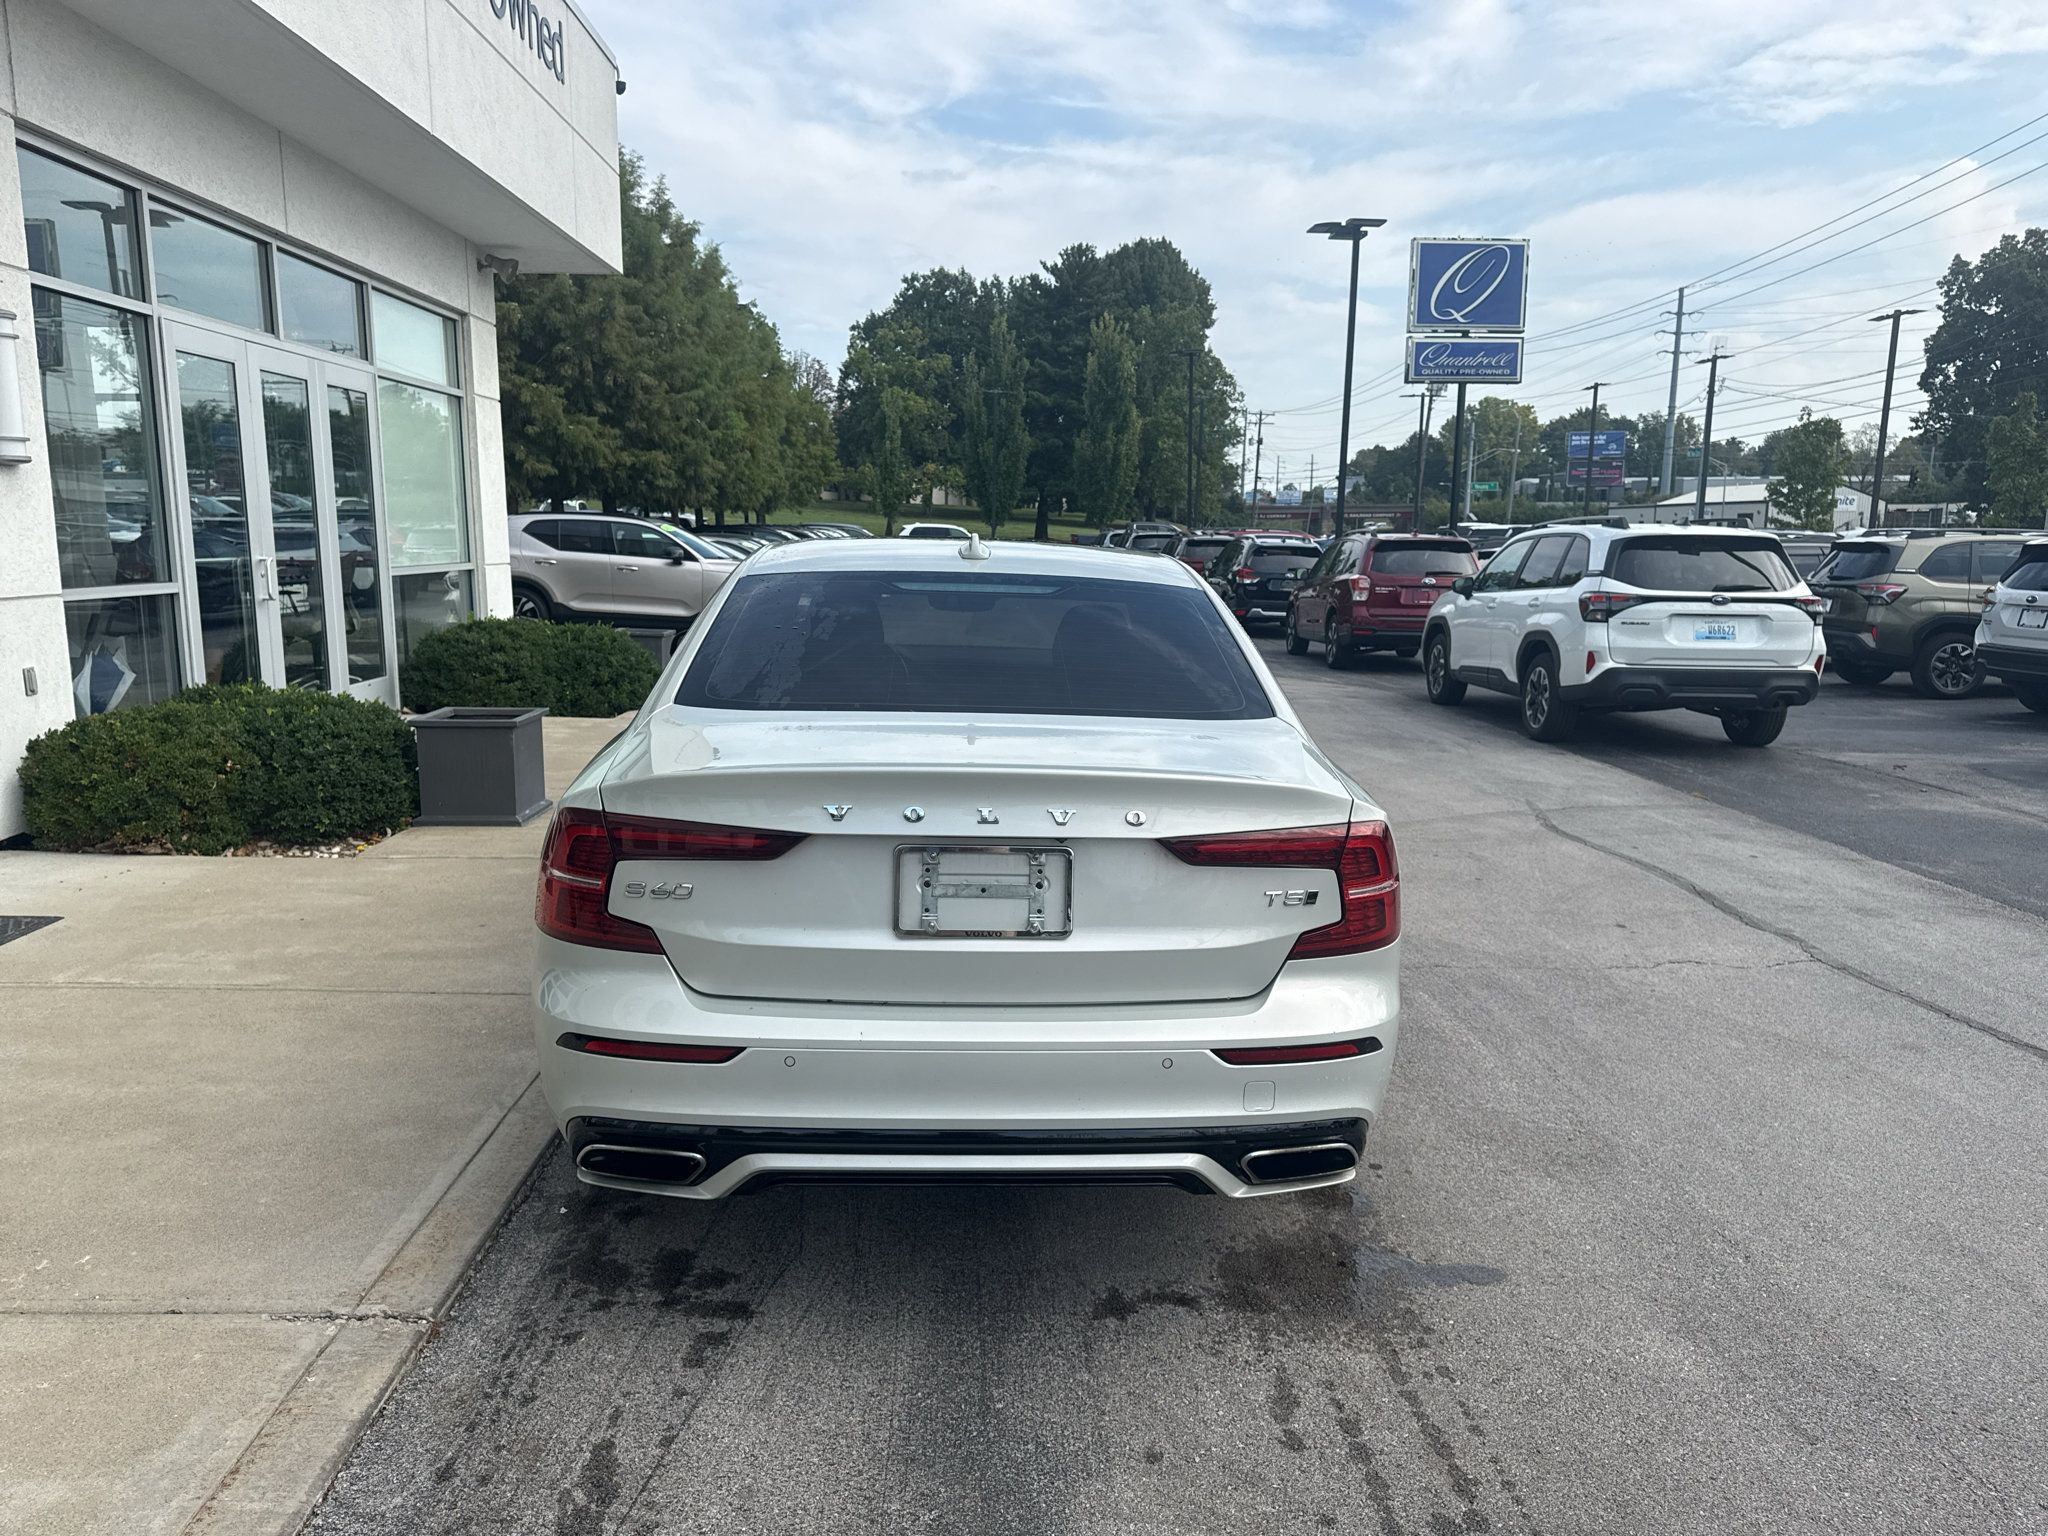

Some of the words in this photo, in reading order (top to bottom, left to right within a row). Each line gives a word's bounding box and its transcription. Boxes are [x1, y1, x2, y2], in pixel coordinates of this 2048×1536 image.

[1430, 245, 1511, 323] Q
[1419, 342, 1514, 367] Quantrell
[823, 804, 1147, 827] VOLVO
[624, 881, 694, 900] S60
[1264, 889, 1305, 908] T5
[964, 930, 1003, 938] VOLVO
